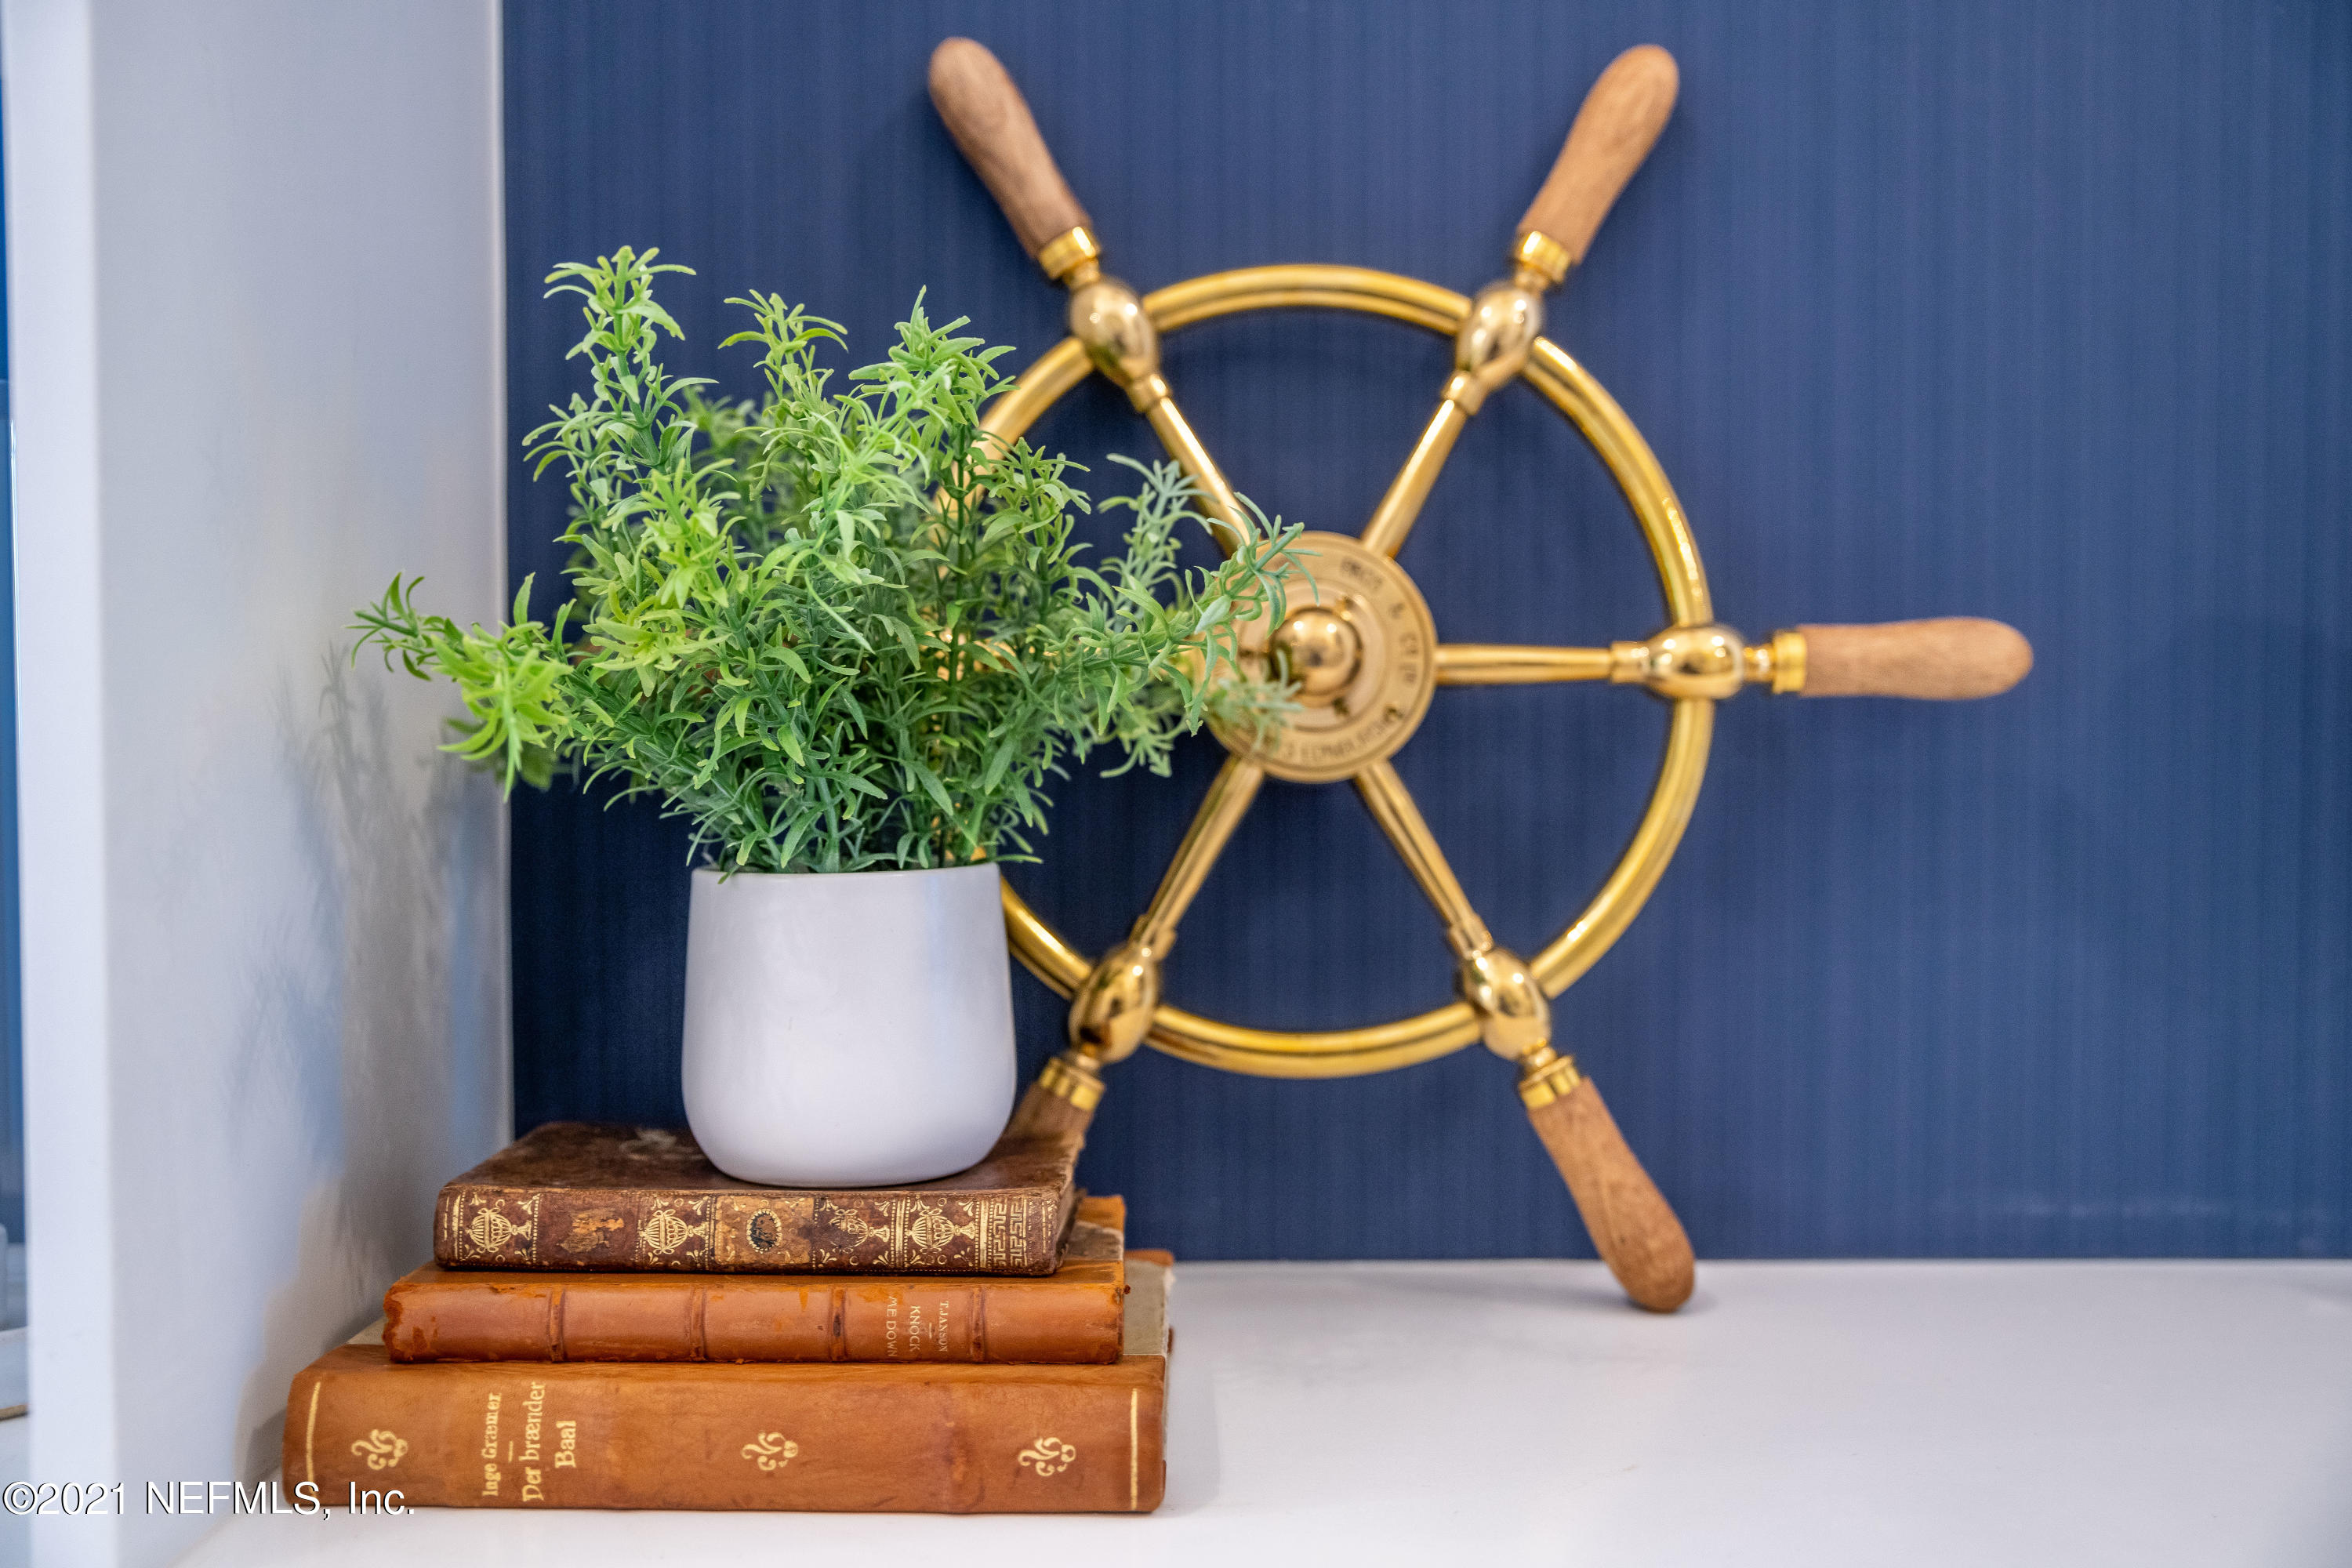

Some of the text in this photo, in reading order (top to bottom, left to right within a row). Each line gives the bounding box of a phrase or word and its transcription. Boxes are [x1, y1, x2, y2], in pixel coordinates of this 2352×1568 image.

[886, 1296, 898, 1357] ME DOWN
[909, 1305, 921, 1352] KNOCK
[518, 1381, 546, 1502] Der brænder
[554, 1419, 576, 1468] Baal
